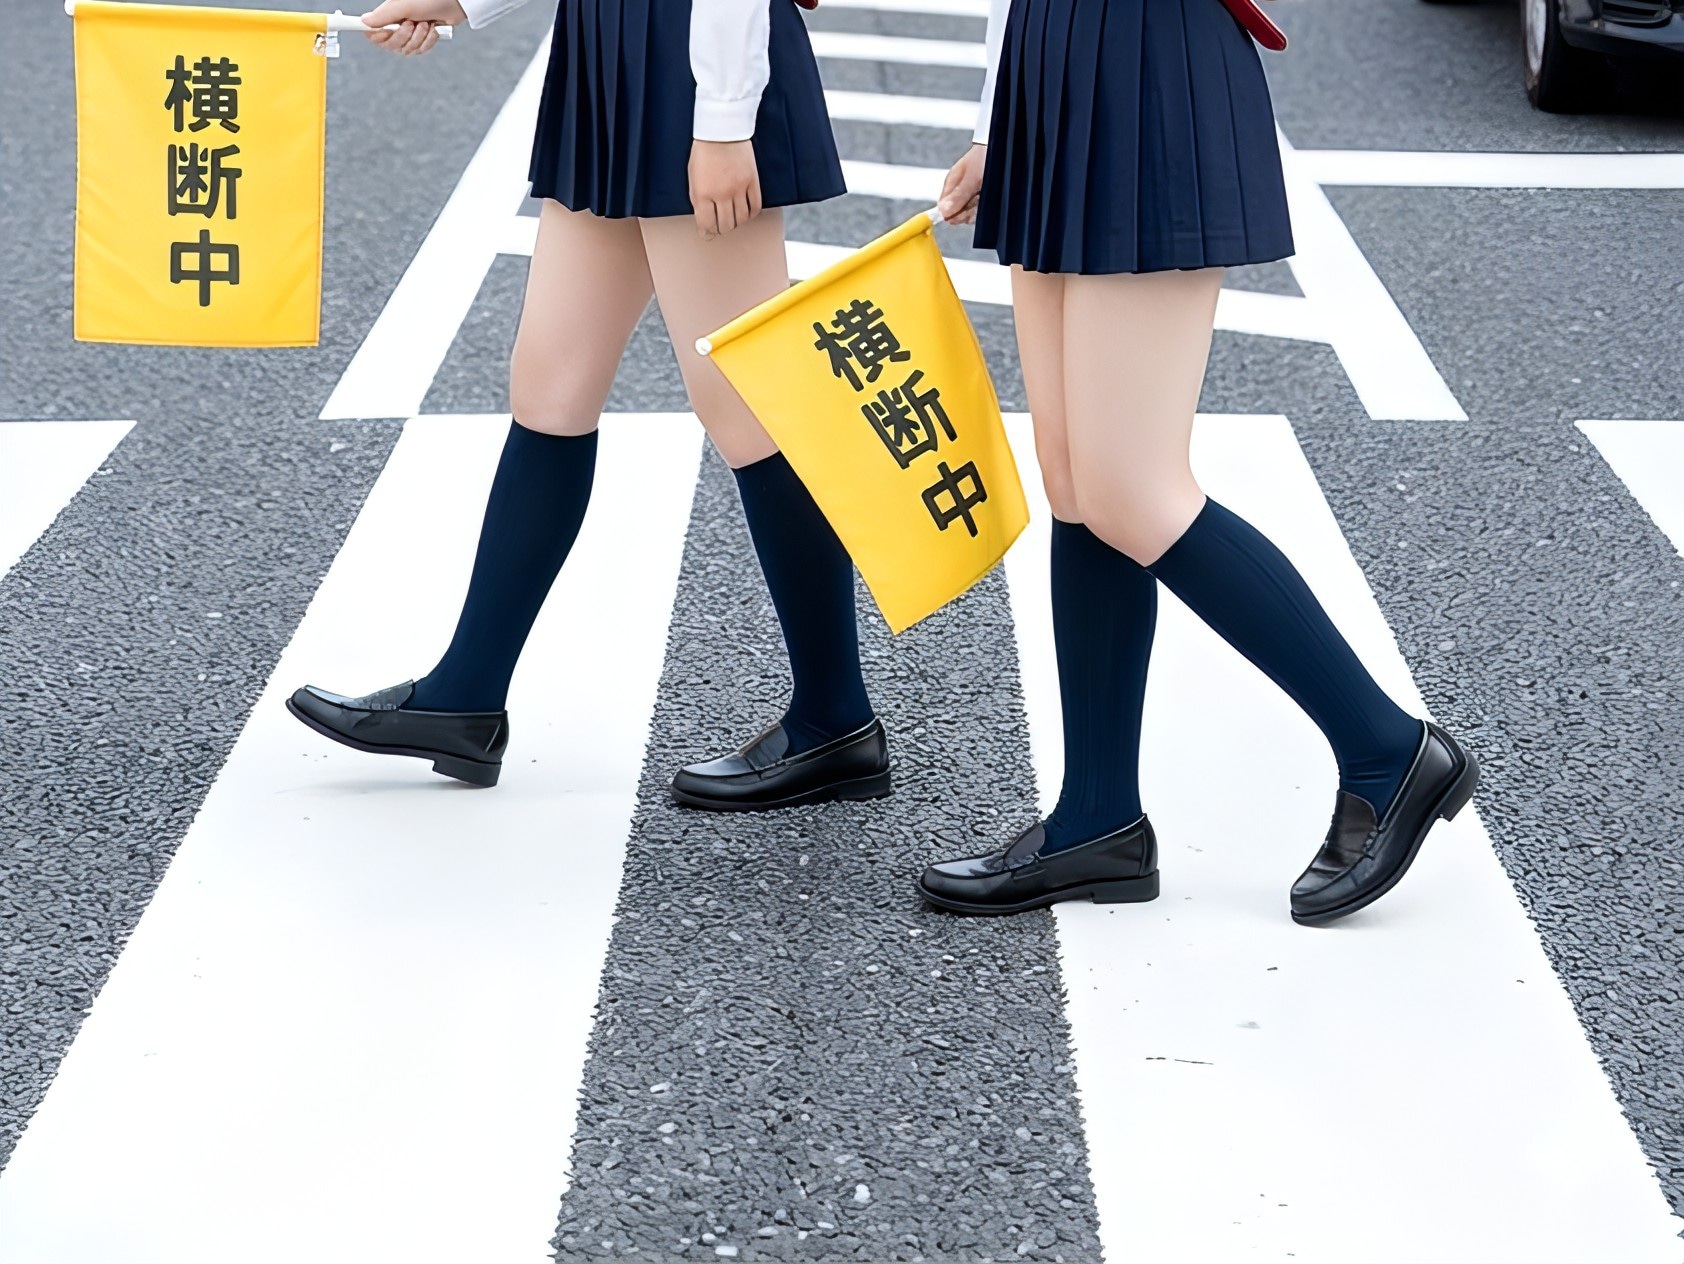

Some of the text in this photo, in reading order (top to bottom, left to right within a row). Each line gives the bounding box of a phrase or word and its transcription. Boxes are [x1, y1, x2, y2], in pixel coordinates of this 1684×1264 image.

[165, 55, 242, 306] 横断中
[813, 300, 987, 537] 横断中
